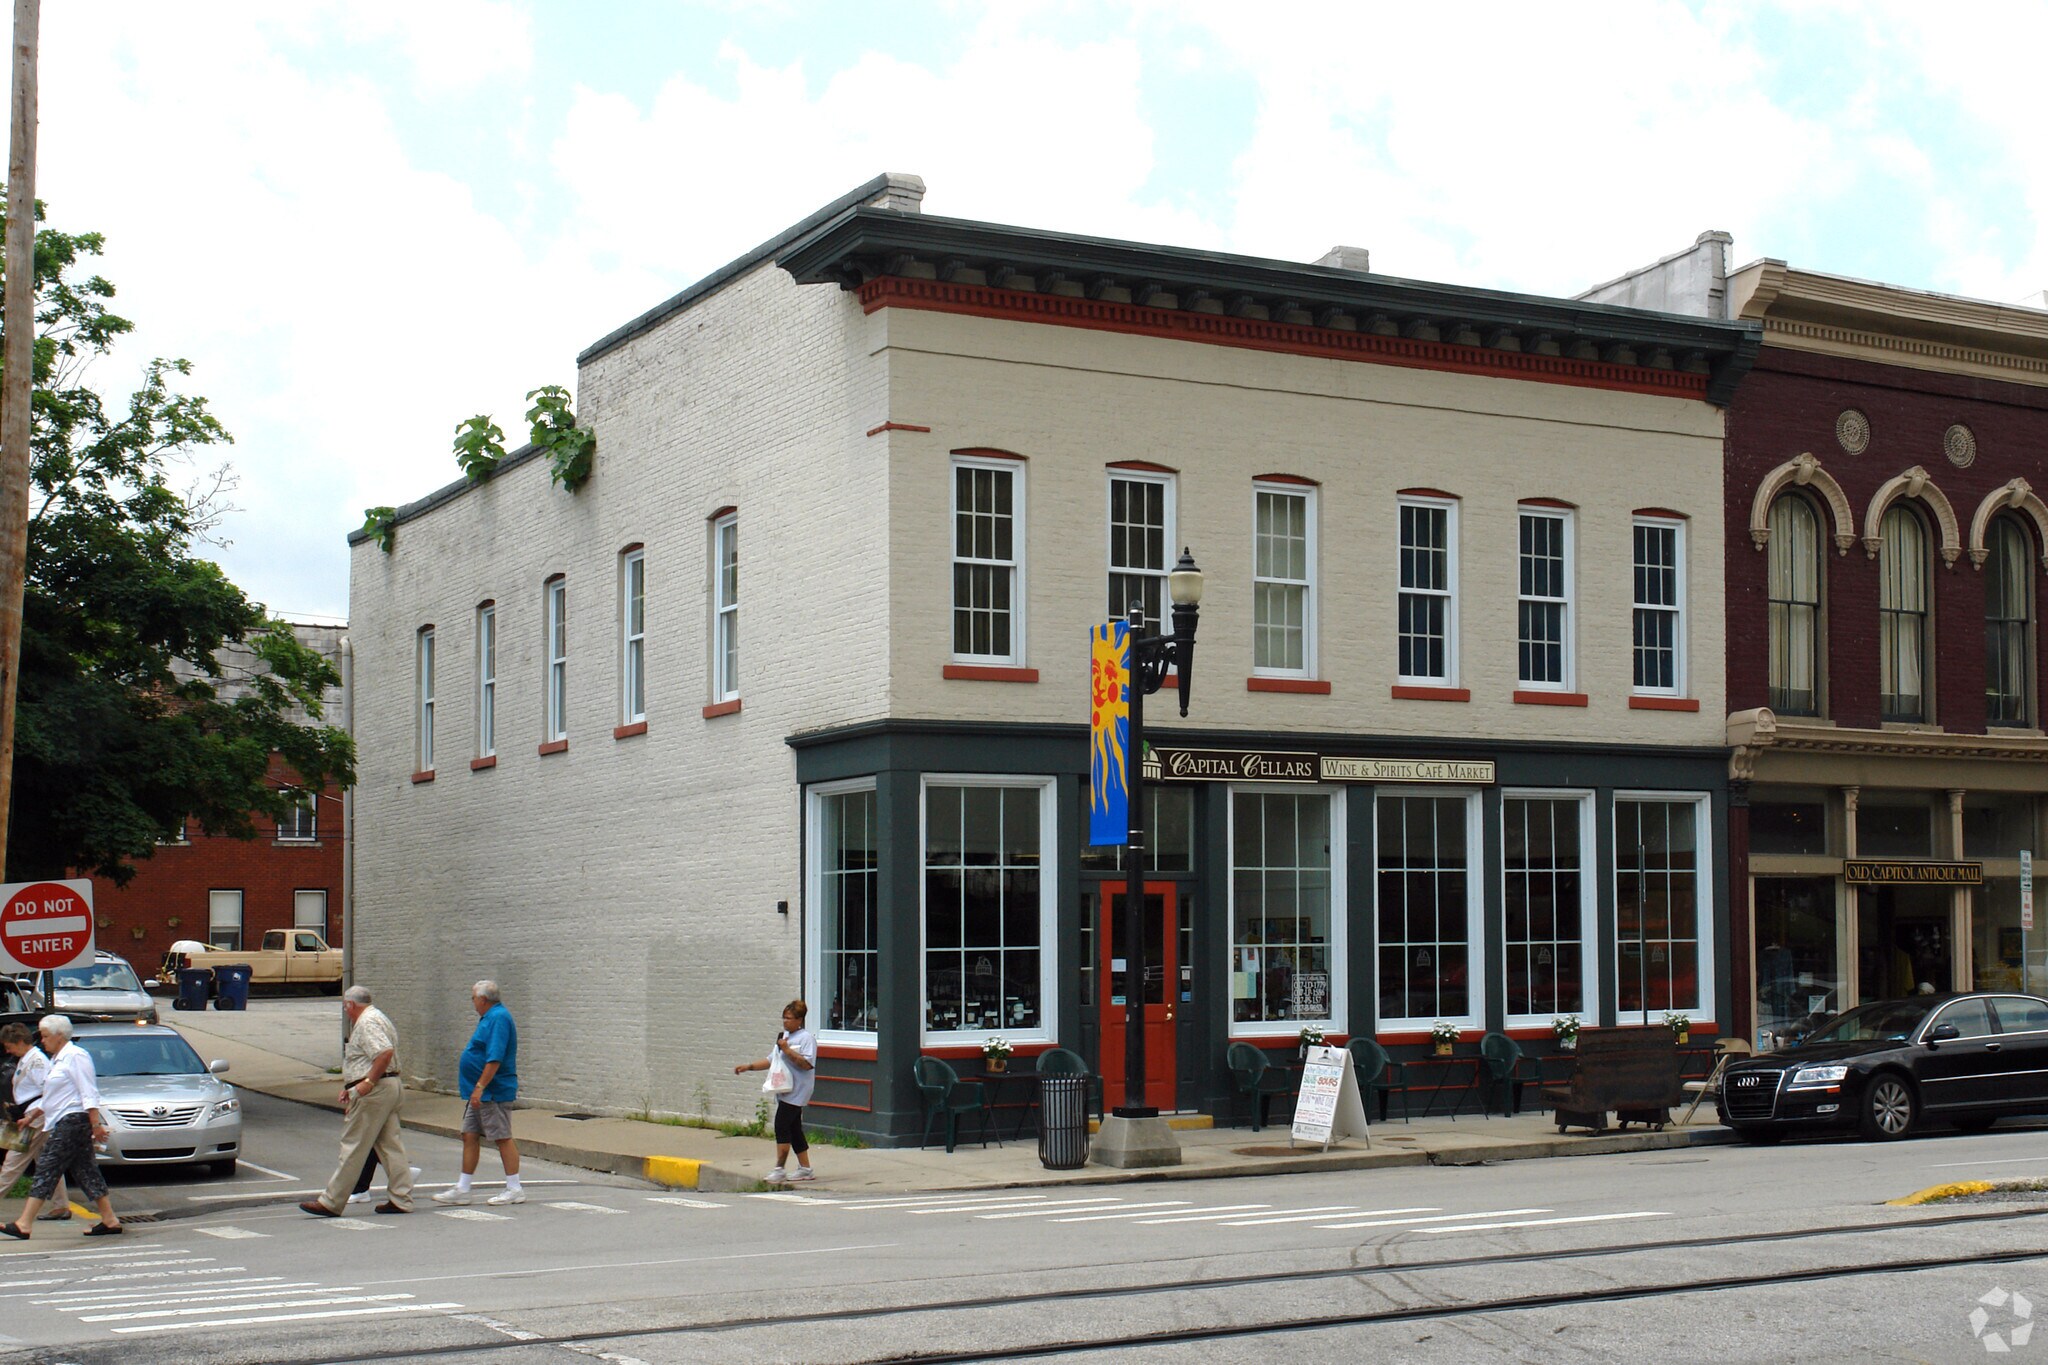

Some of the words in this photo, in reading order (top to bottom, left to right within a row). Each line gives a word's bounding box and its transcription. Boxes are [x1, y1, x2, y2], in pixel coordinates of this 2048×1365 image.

[1169, 752, 1238, 776] CAPITAL
[1240, 754, 1312, 777] CELLARS
[1325, 760, 1357, 776] WINE
[1361, 765, 1369, 776] &
[1373, 761, 1412, 777] SPIRITS
[1416, 762, 1443, 778] CAFÉ
[1447, 764, 1490, 779] MARKET
[1847, 865, 1870, 879] OLD
[1871, 865, 1916, 880] CAPITOL
[1917, 866, 1956, 881] ANTIQUE
[1957, 867, 1980, 881] MALL
[15, 901, 37, 916] DO
[43, 898, 74, 913] NOT
[21, 937, 73, 954] ENTER
